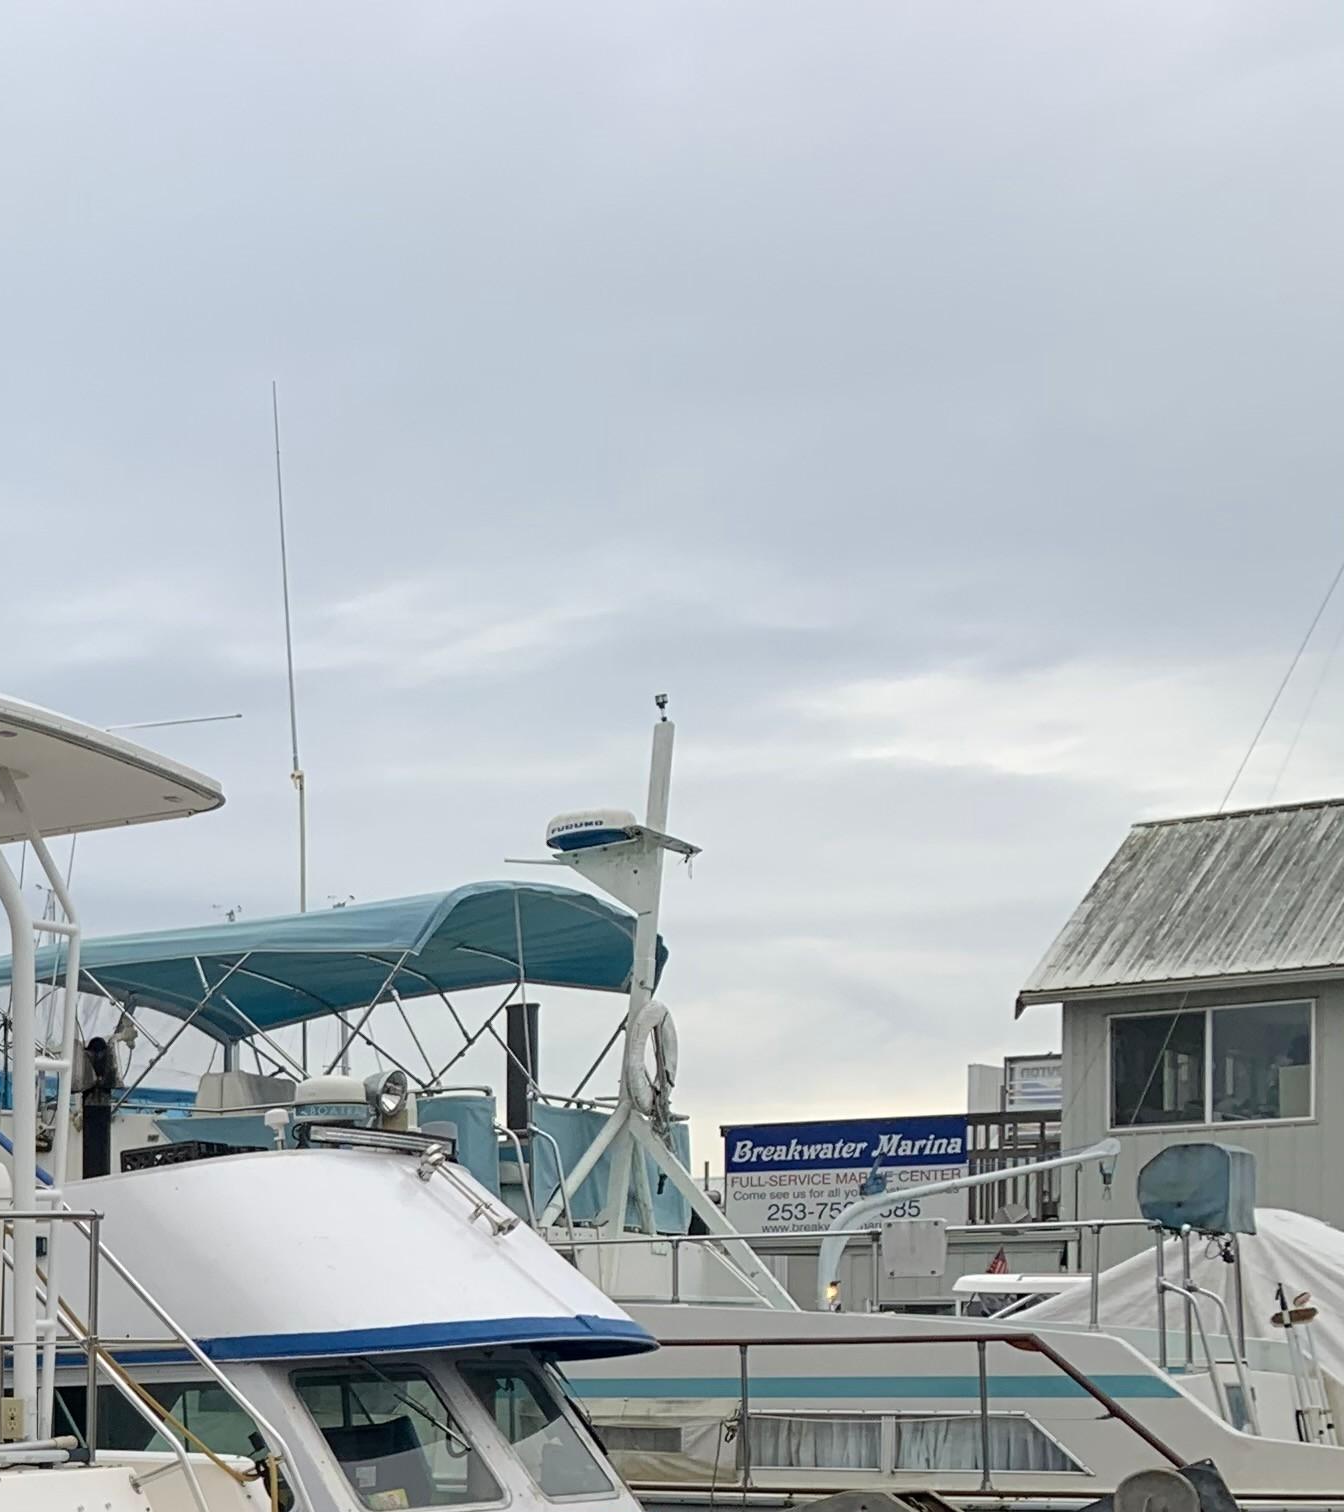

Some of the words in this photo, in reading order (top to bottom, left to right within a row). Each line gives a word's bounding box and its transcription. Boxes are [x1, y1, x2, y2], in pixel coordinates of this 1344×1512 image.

[731, 1136, 869, 1164] Breakwater
[871, 1133, 963, 1158] Marina
[730, 1173, 832, 1188] FULL-SERVICE
[835, 1170, 894, 1185] MARNE
[898, 1168, 962, 1183] CENTER
[733, 1190, 767, 1201] Come
[769, 1190, 790, 1200] see
[792, 1190, 807, 1199] us
[809, 1189, 825, 1199] for
[827, 1188, 841, 1198] all
